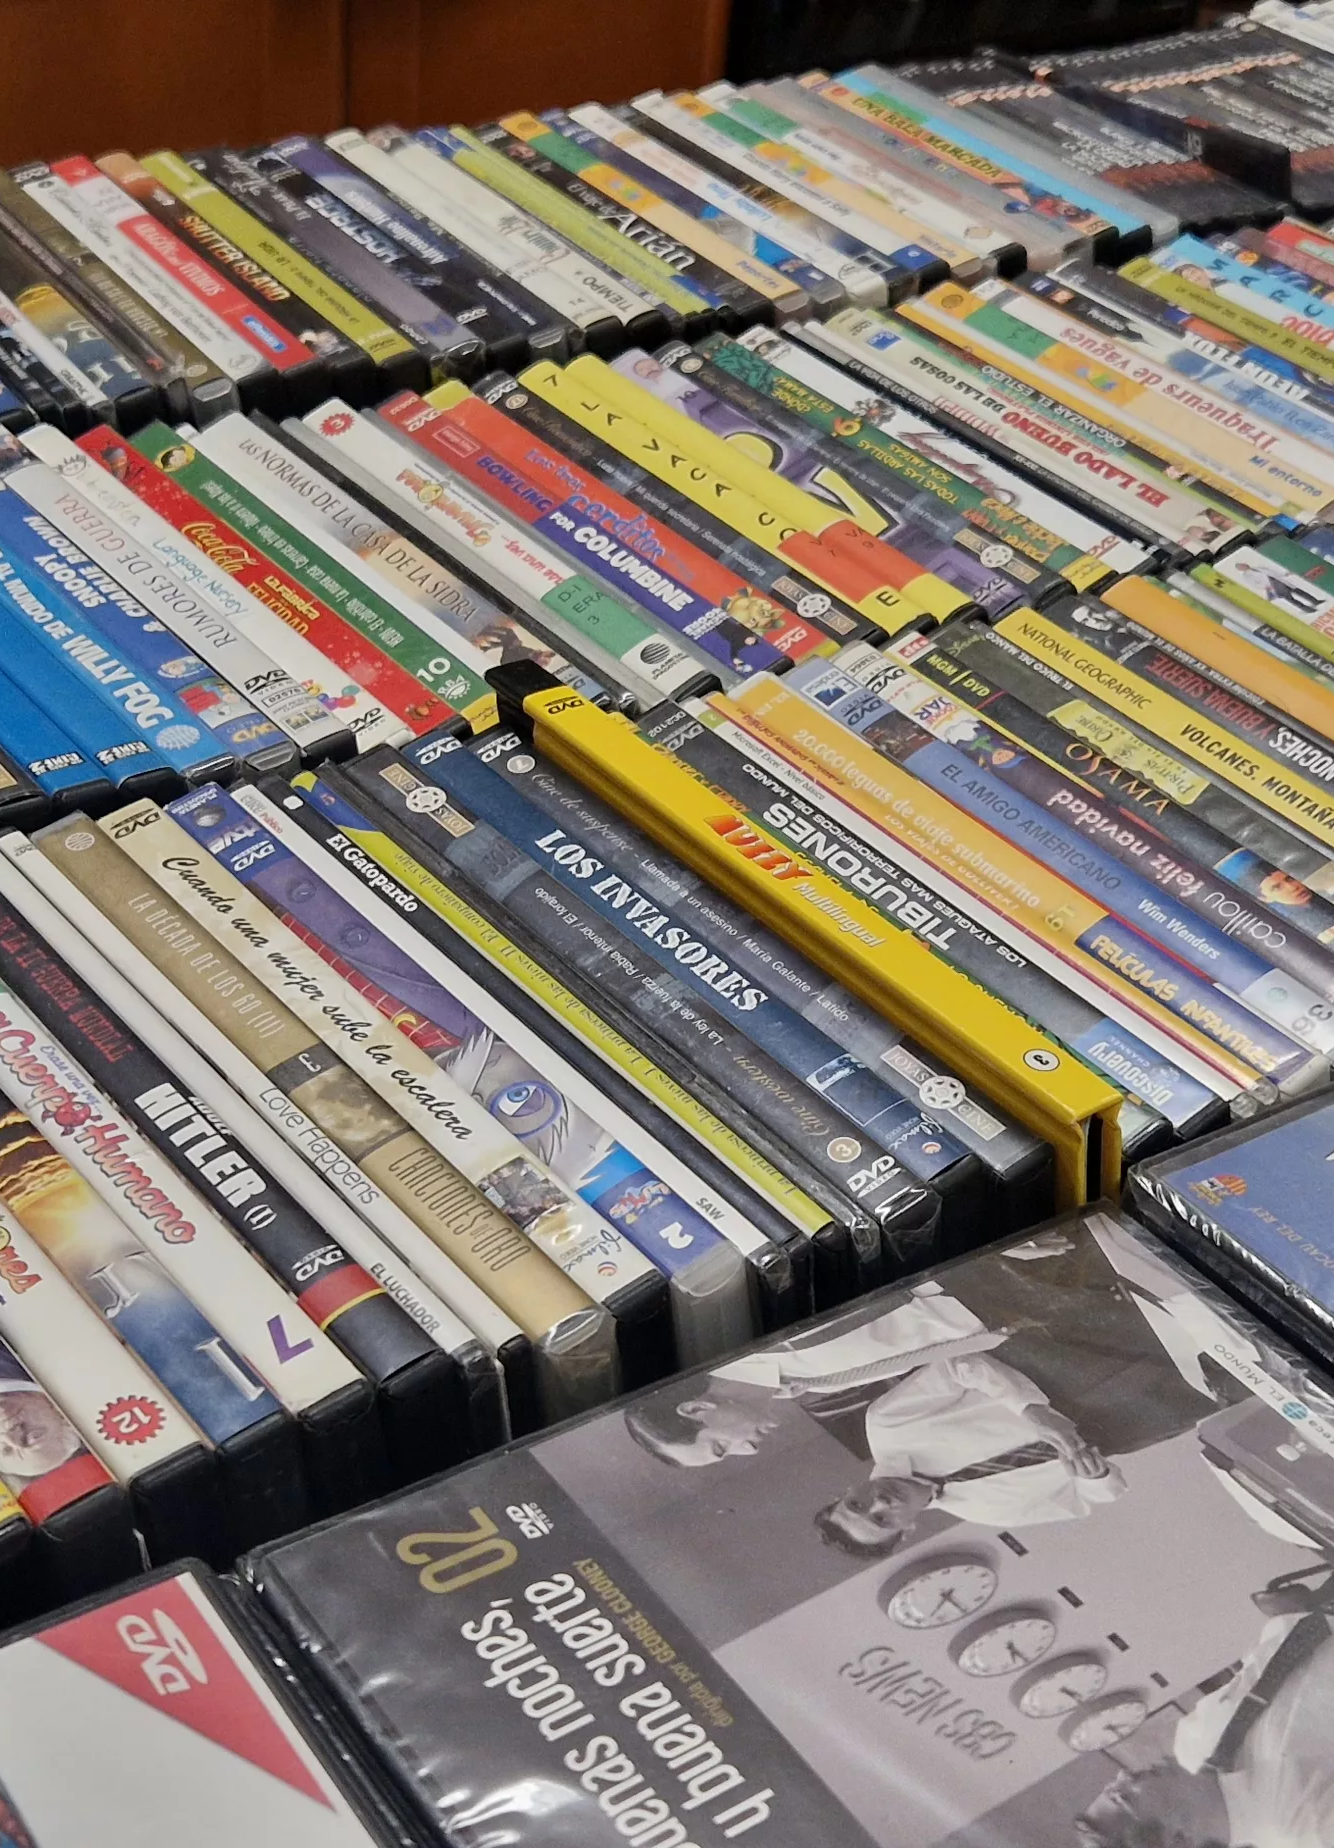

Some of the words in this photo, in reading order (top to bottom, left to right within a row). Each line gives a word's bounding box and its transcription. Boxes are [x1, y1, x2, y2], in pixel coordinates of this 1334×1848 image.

[177, 213, 243, 262] SHUTTER
[230, 260, 292, 303] ISLAND
[909, 354, 958, 385] COSAS
[957, 379, 986, 401] LAS
[979, 361, 1037, 396] ESTUDIO
[980, 395, 1008, 413] DE
[1032, 391, 1056, 408] EL
[1052, 403, 1128, 449] ORGANIZAR
[238, 438, 263, 468] LAS
[999, 407, 1076, 450] BUENO
[253, 446, 322, 507] NORMAS
[1070, 449, 1135, 489] LADO
[54, 493, 122, 548] GUERRA
[316, 490, 341, 520] DE
[333, 504, 355, 531] LA
[1129, 486, 1168, 509] EL
[115, 543, 147, 574] DE
[351, 516, 398, 560] CASA
[476, 454, 552, 513] BOWLING
[547, 512, 574, 532] FOR
[563, 534, 688, 615] COLUMBINE
[396, 549, 420, 576] DE
[401, 569, 437, 591] LA
[147, 576, 237, 649] RUMORES
[418, 587, 473, 622] SIDRA
[0, 578, 47, 624] MUNDO
[38, 620, 65, 642] DE
[59, 632, 132, 692] WILLY
[107, 680, 171, 731] FOG
[1015, 621, 1079, 675] NATIONAL
[1072, 657, 1153, 711] GEOGRAPHIC
[1148, 652, 1215, 698] SUERTE
[1204, 687, 1266, 731] BUENA
[742, 760, 792, 796] MUNDO
[1182, 725, 1259, 776] VOLCANES.
[790, 793, 818, 815] DEL
[1066, 743, 1169, 814] OSAMA
[940, 762, 968, 782] EL
[963, 781, 1021, 820] AMIGO
[1019, 820, 1120, 889] AMERICANO
[1049, 792, 1148, 855] navidad
[325, 832, 352, 862] El
[340, 842, 420, 914] Gatopardo
[763, 802, 964, 944] TIBURONES
[816, 814, 931, 896] TERRORIFICOS
[1148, 851, 1210, 896] feliz
[532, 830, 603, 881] LOS
[591, 877, 767, 1012] INVASORES
[788, 886, 883, 950] Multilingual
[926, 893, 961, 917] MAS
[1138, 896, 1176, 922] Wim
[1167, 918, 1227, 958] Wenders
[1206, 889, 1290, 948] caillou
[955, 915, 1007, 951] ATAQUES
[1000, 946, 1030, 967] LOS
[161, 854, 235, 918] Cuando
[231, 913, 270, 950] una
[267, 941, 328, 1012] mujer
[321, 989, 370, 1044] sube
[365, 1040, 395, 1070] la
[389, 1062, 474, 1141] escalera
[131, 1083, 270, 1207] HITLER
[240, 1204, 276, 1230] (I)
[260, 1084, 313, 1128] Love
[300, 1125, 379, 1204] Happens
[696, 1197, 724, 1220] SAW
[396, 1507, 518, 1594] 02
[572, 1557, 632, 1625] CLOONEY
[524, 1573, 646, 1686] suerte
[620, 1600, 669, 1663] GEORGE
[461, 1598, 595, 1742] noches,
[669, 1649, 690, 1675] por
[838, 1641, 947, 1732] NEWS
[686, 1671, 735, 1728] dirigida
[619, 1682, 746, 1811] buena
[921, 1699, 1019, 1765] CBS
